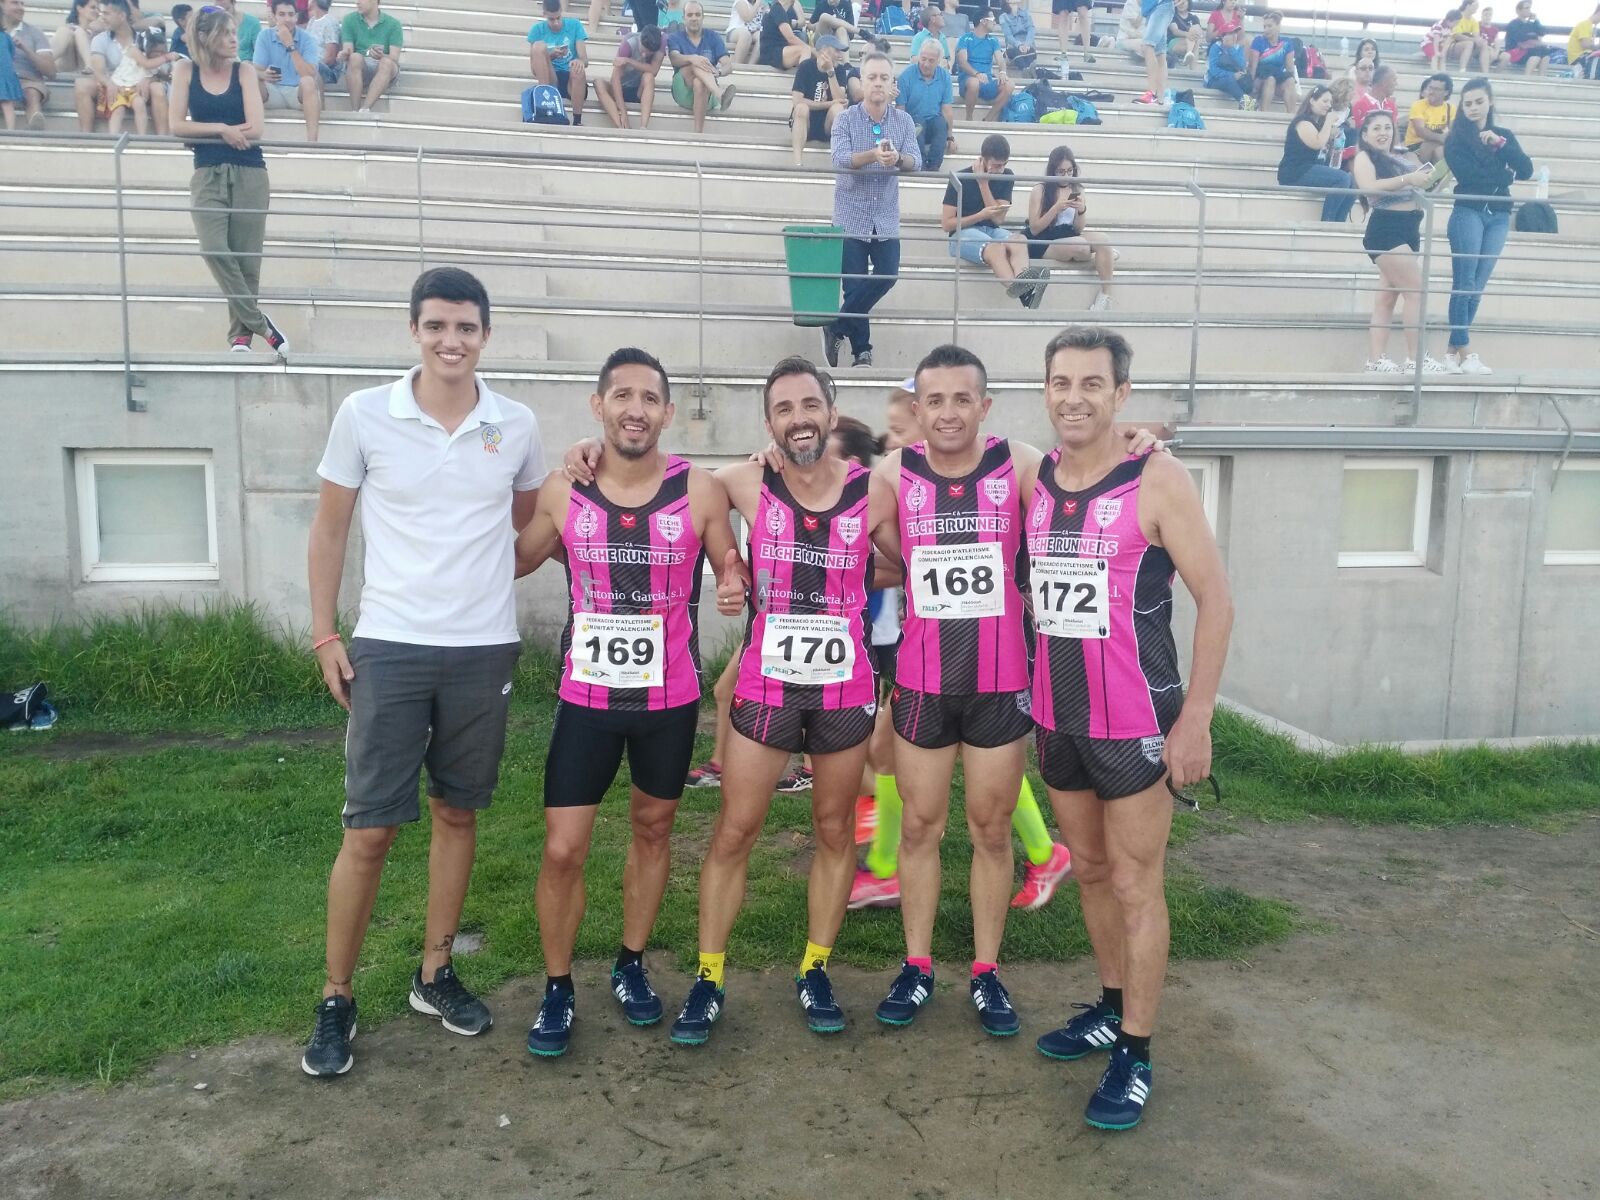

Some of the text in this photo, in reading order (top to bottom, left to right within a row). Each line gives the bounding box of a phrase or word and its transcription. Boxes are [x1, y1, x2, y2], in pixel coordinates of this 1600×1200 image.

[907, 517, 1010, 537] ELCHE RUNNERS
[574, 547, 686, 564] ELCHE RUNNERS
[760, 543, 859, 569] ELCHE RUNNERS
[1028, 537, 1119, 557] ELCHE RUNNERS
[922, 565, 995, 596] 168
[584, 586, 626, 600] Antonio
[671, 587, 685, 598] s.l.
[758, 585, 804, 600] Antonio
[1039, 580, 1098, 614] 172
[585, 635, 655, 666] 169
[776, 635, 847, 665] 170
